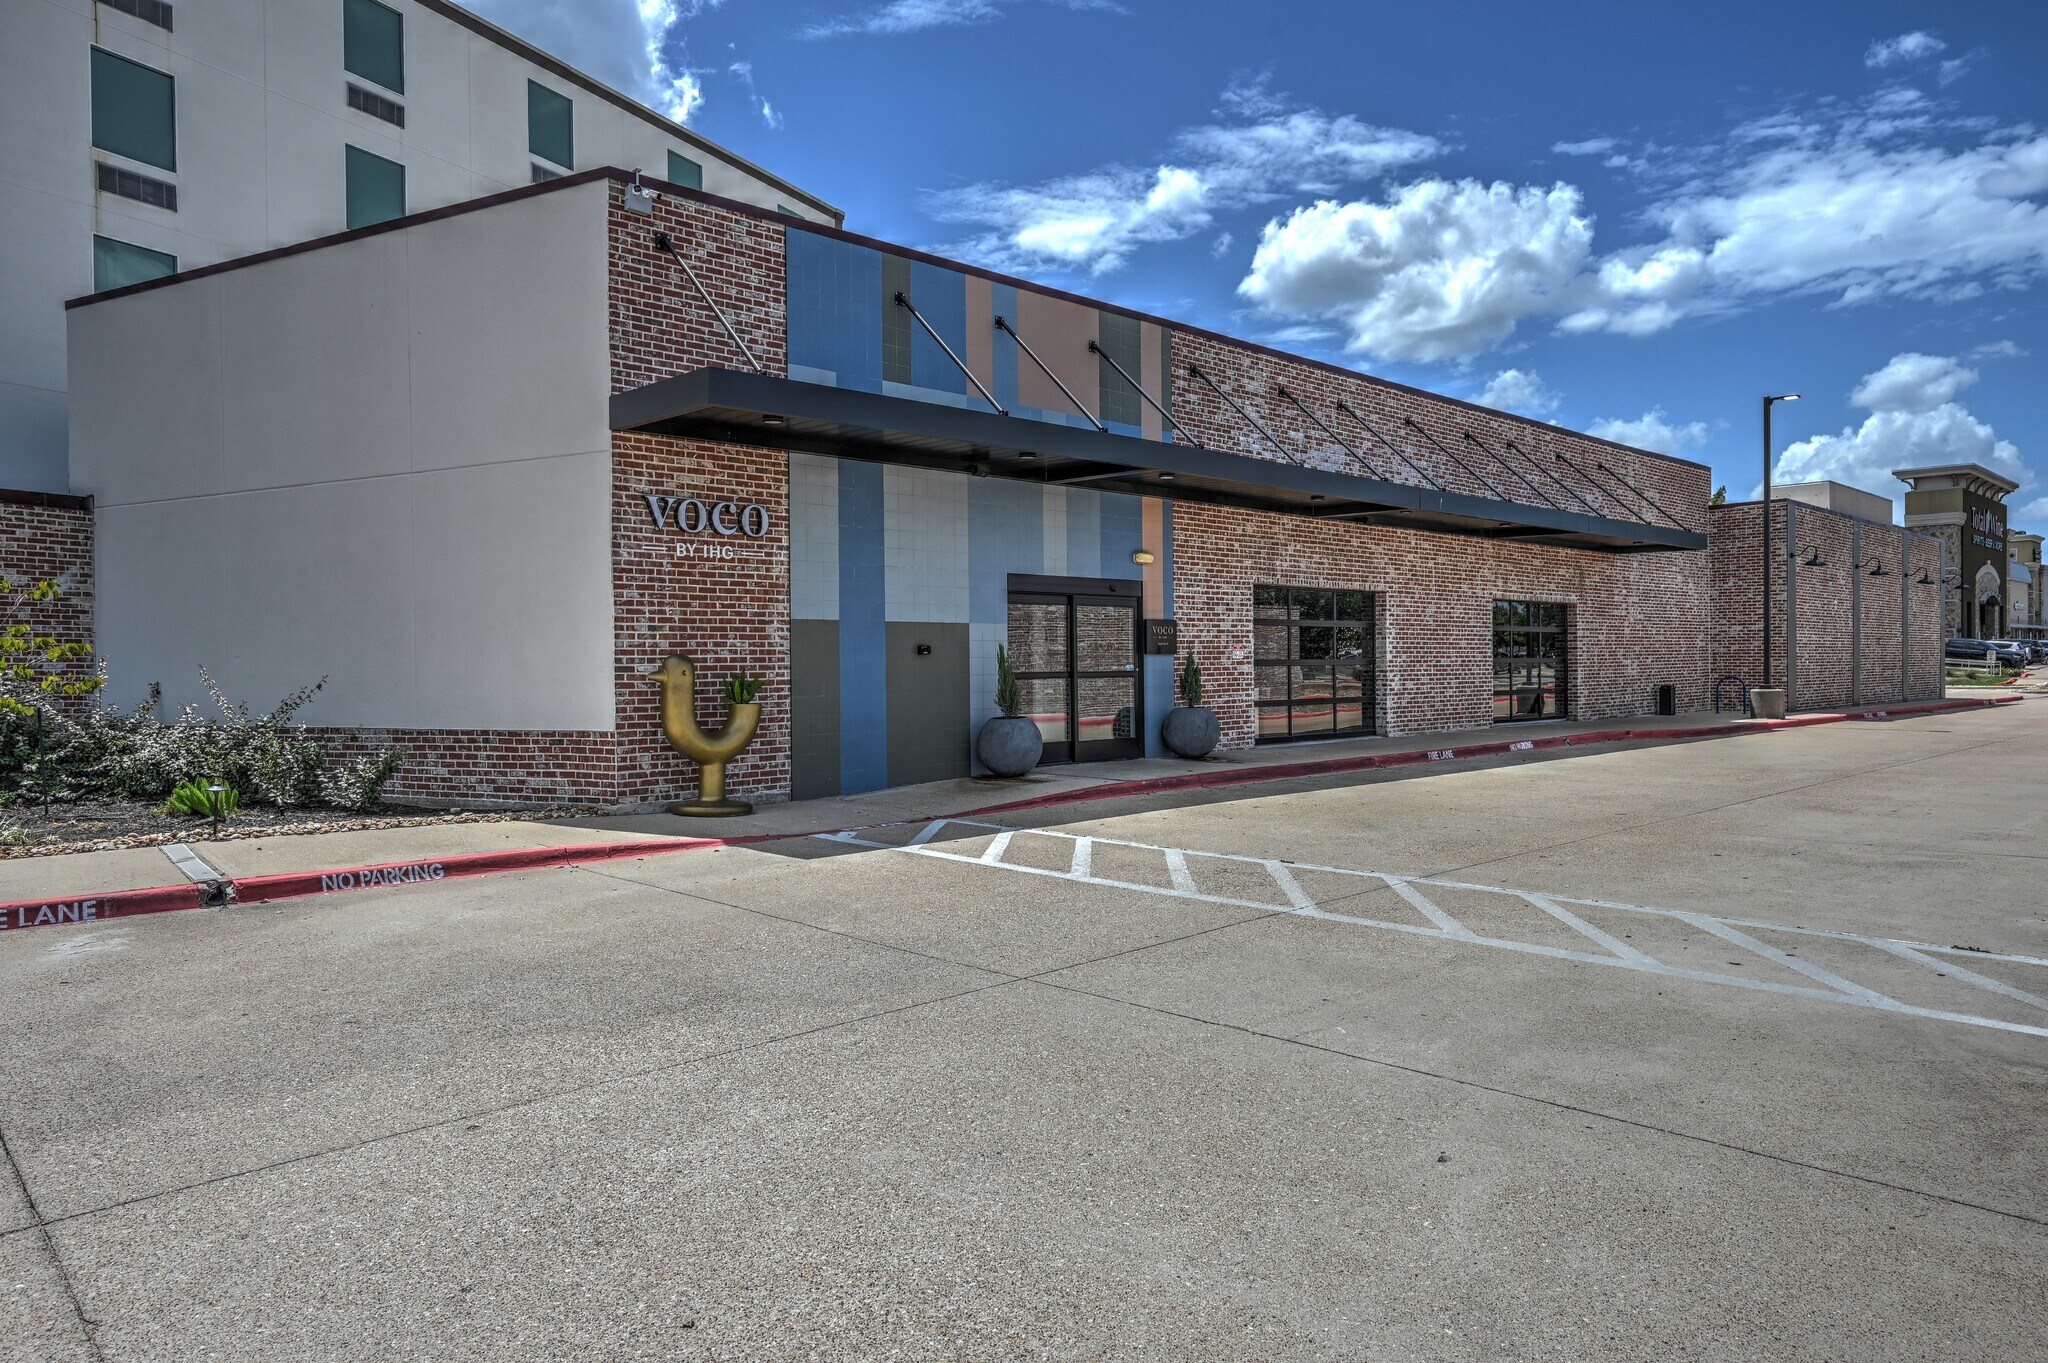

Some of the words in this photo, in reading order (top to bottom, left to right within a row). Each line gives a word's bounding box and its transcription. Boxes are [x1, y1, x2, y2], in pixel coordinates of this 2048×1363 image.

[676, 542, 697, 557] BY
[703, 544, 734, 559] IHG
[1427, 751, 1440, 760] FIRE
[1440, 750, 1454, 759] LANE
[321, 871, 355, 892] NO
[359, 863, 445, 887] PARKING
[19, 900, 97, 927] LANE
